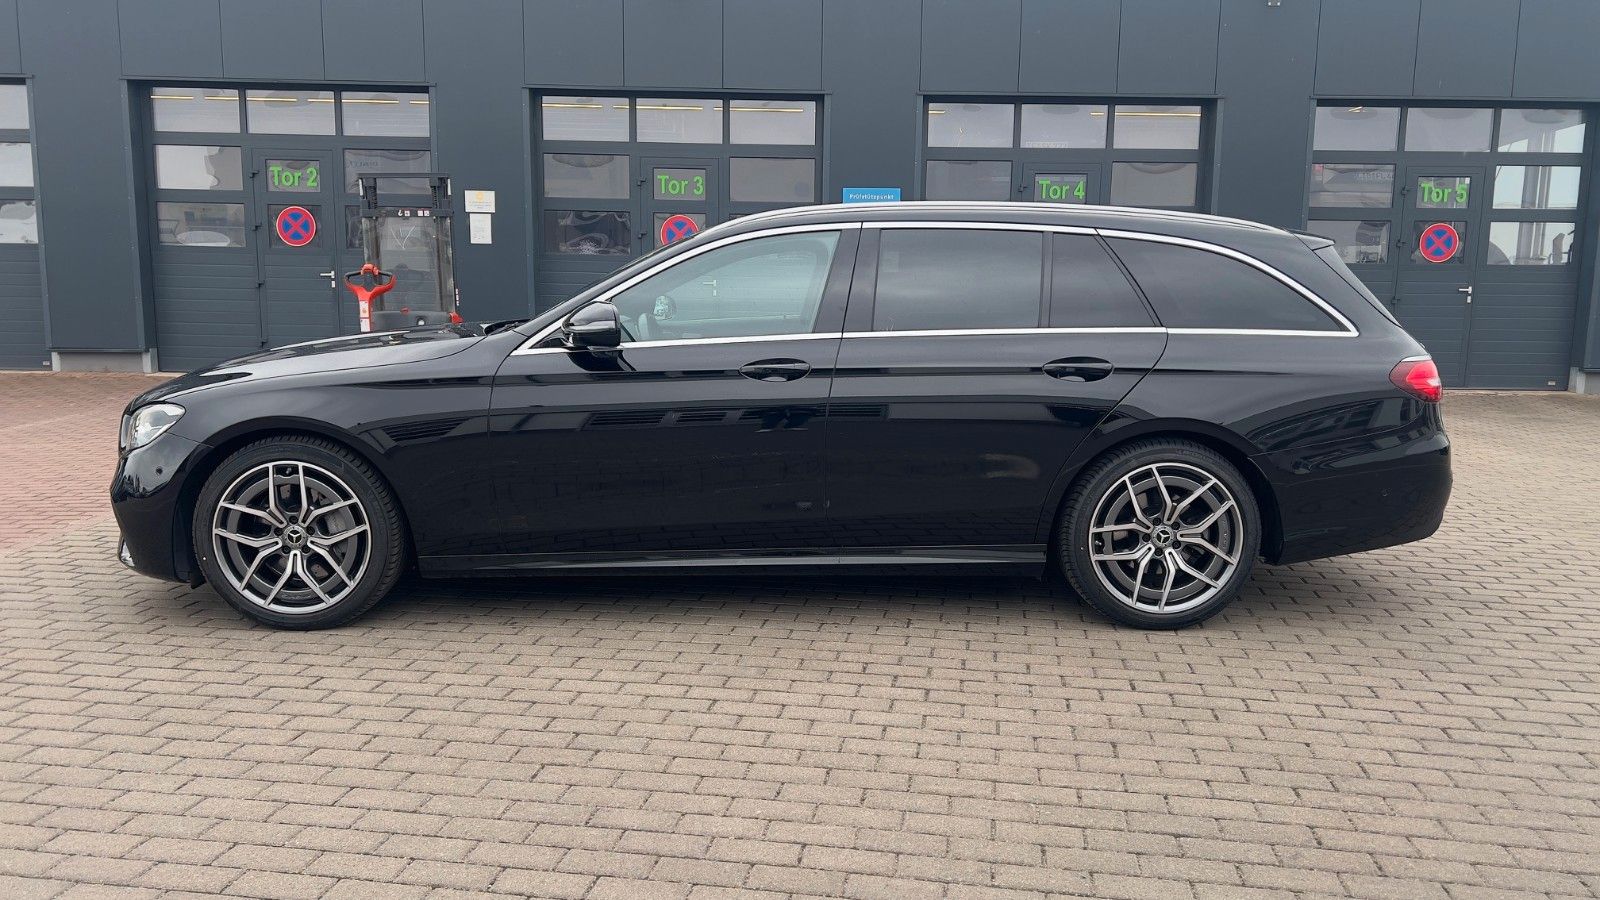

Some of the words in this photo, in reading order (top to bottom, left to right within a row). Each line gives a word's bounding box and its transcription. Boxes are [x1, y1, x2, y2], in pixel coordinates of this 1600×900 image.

[269, 165, 302, 188] Tor
[306, 166, 319, 188] 2
[656, 174, 689, 195] Tor
[693, 175, 705, 195] 3
[1038, 179, 1070, 199] Tor
[1073, 181, 1086, 200] 4
[1420, 182, 1453, 203] Tor
[1456, 183, 1469, 203] 5
